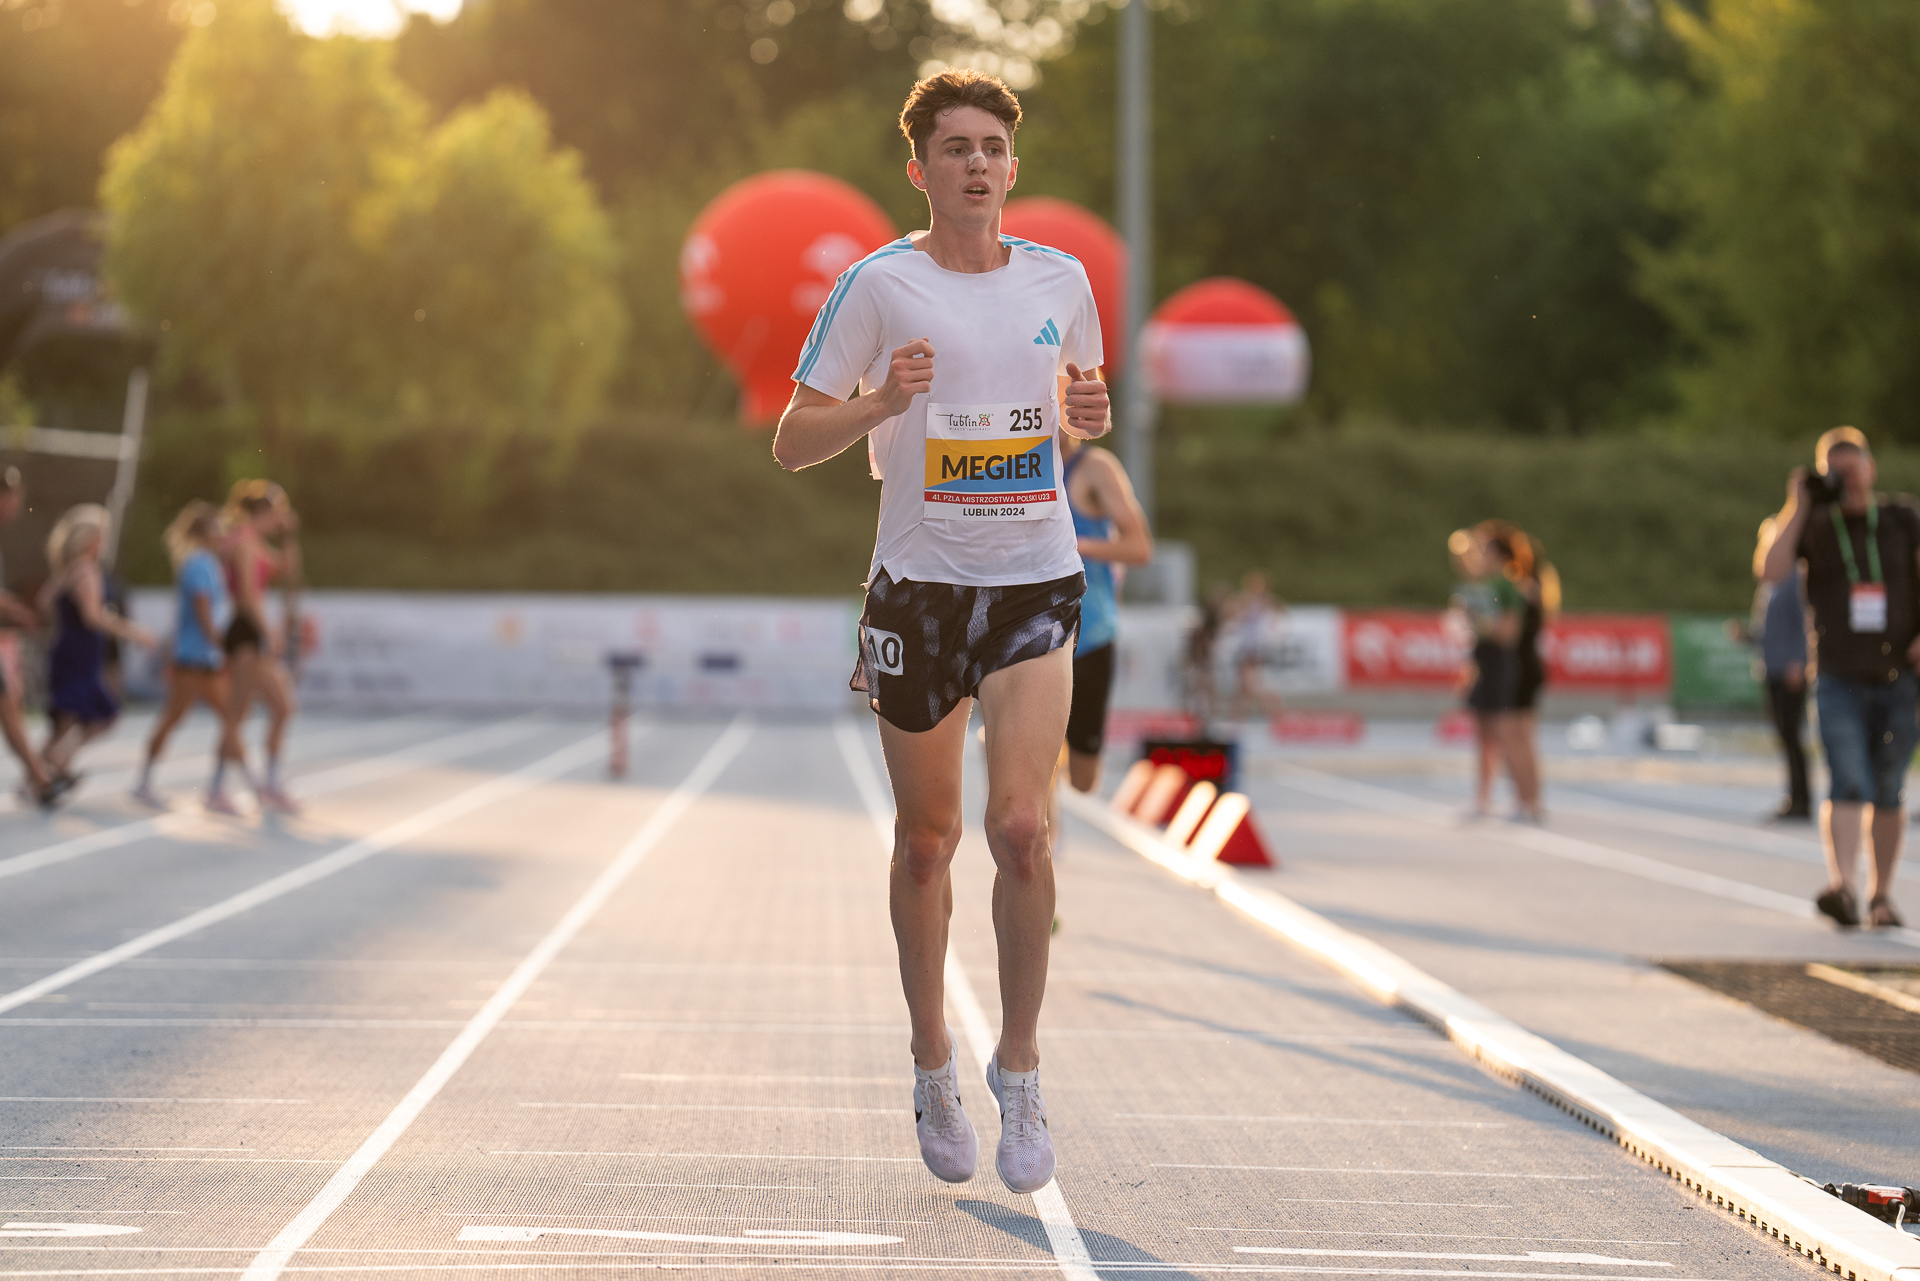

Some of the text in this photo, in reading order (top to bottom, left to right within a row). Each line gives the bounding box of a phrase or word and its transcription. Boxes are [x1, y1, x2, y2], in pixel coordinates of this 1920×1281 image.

[1009, 407, 1043, 432] 255
[941, 453, 1042, 480] MEGIER
[932, 493, 1050, 504] 41. PZLA MISTRZOSTWA POLSKI U23
[963, 507, 1025, 517] LUBLIN 2024
[867, 634, 900, 669] 10
